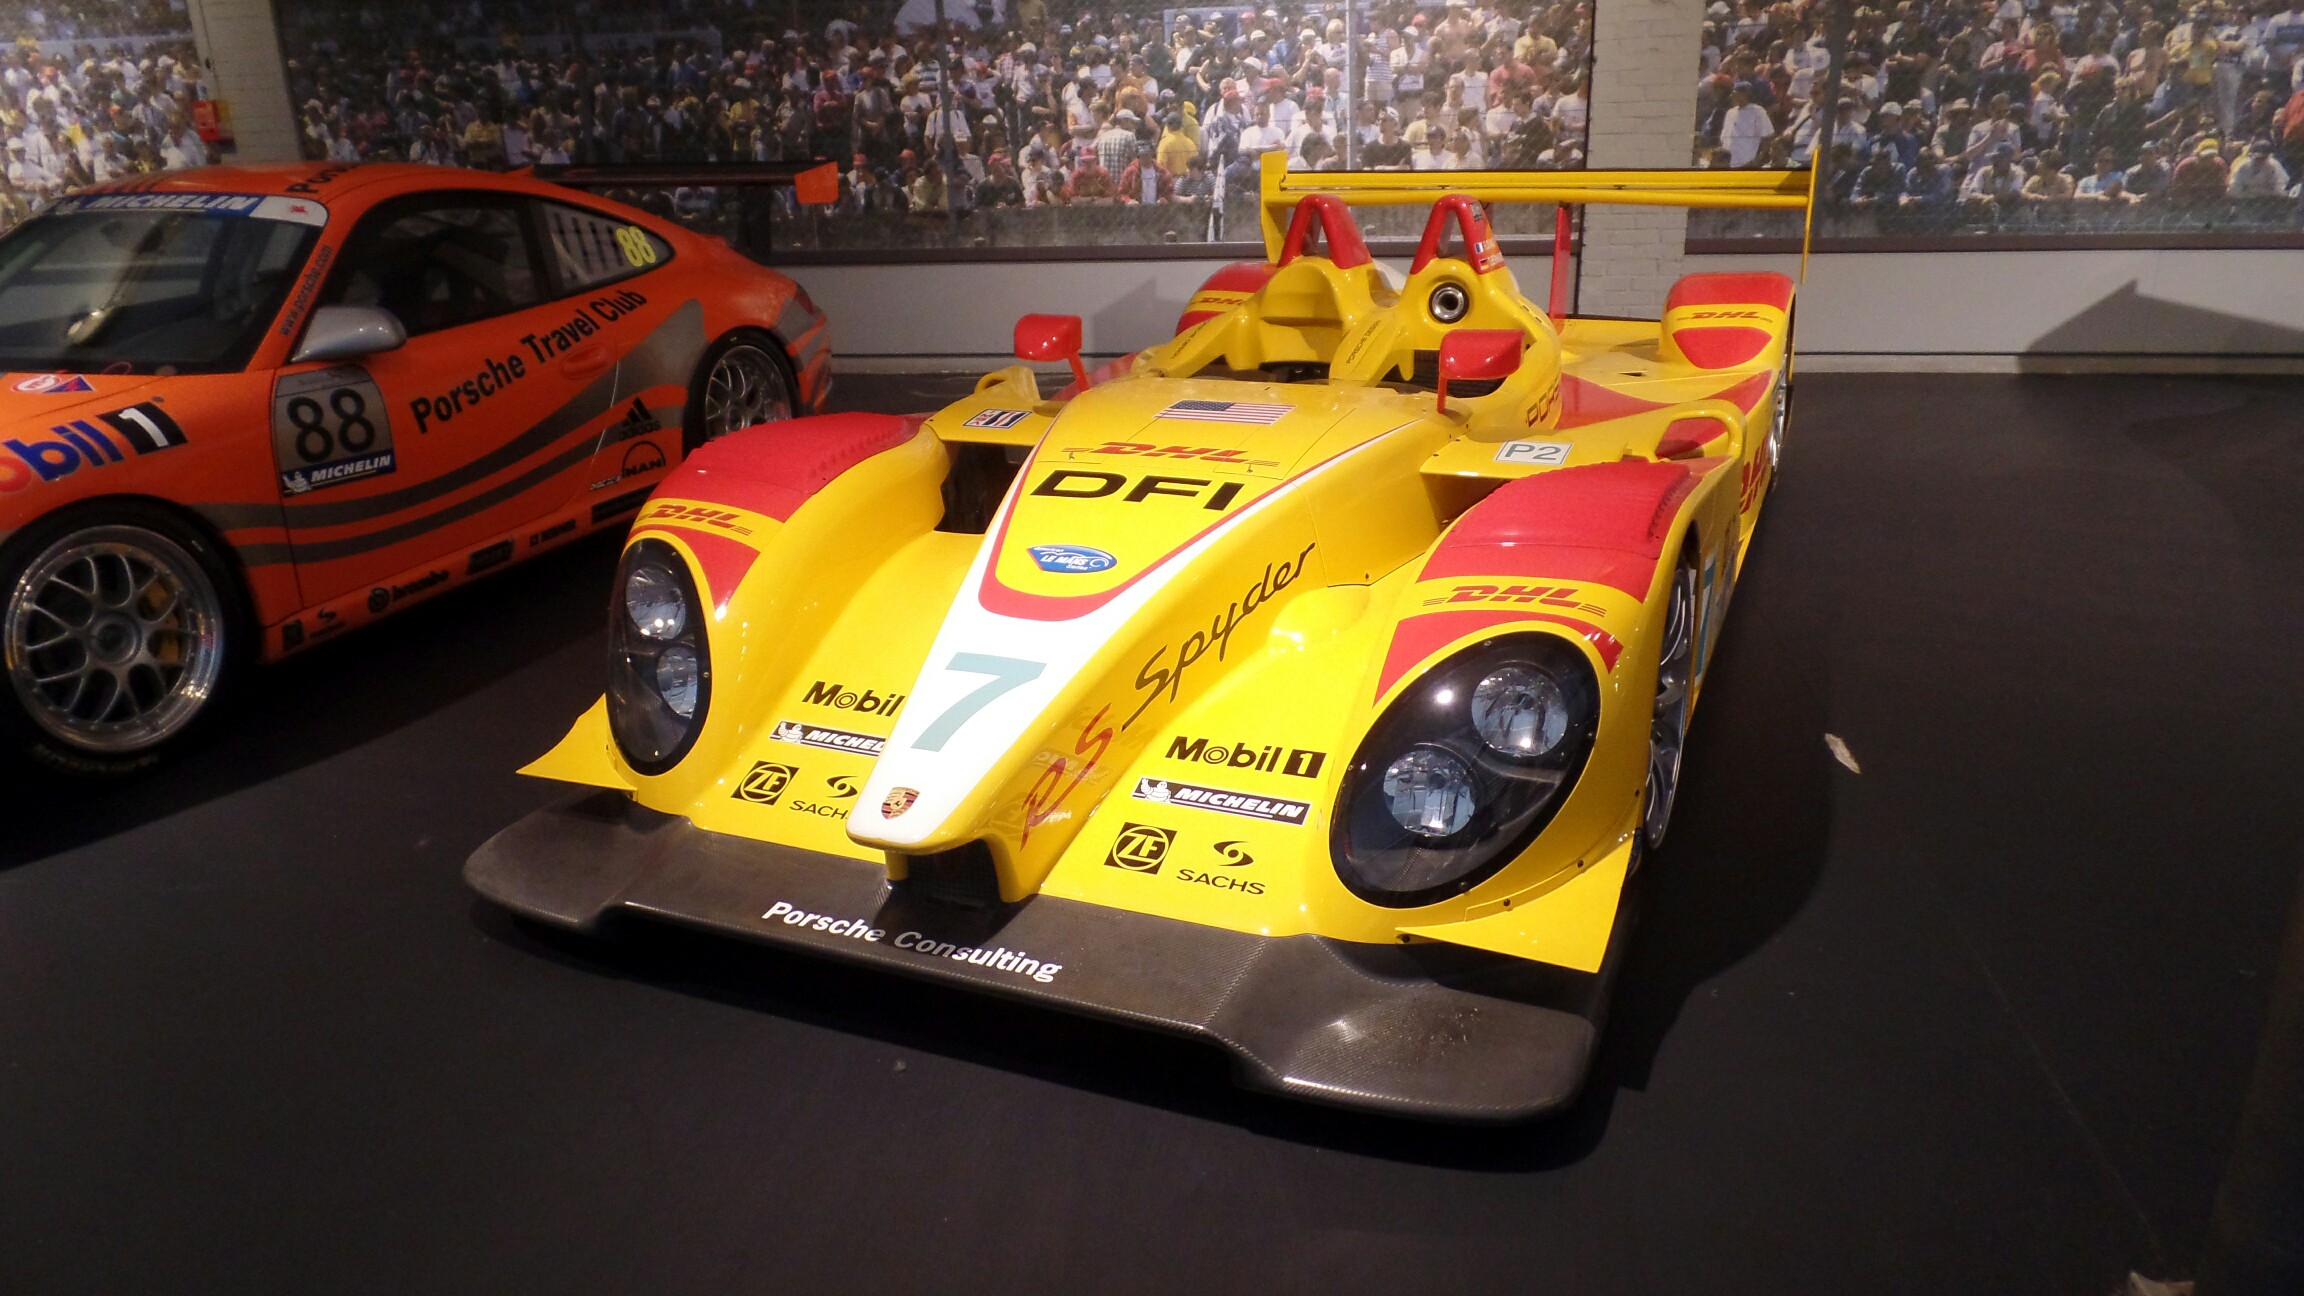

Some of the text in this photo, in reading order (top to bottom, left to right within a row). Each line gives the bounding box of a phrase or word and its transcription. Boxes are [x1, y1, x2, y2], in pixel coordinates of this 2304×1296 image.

[615, 225, 657, 267] 88
[1691, 311, 1760, 319] DHL
[409, 289, 648, 434] Porsche Travel Club
[286, 387, 375, 462] 88
[1090, 441, 1253, 464] DHL
[1504, 443, 1562, 461] P2
[311, 455, 391, 482] MICHELIN
[1029, 469, 1246, 512] DFI
[648, 504, 741, 529] DHL
[1040, 554, 1089, 566] LE MANS
[1446, 584, 1581, 609] DHL
[801, 680, 906, 717] Mobil
[910, 651, 1047, 753] 7
[1020, 542, 1316, 852] RS Spyder
[804, 730, 887, 752] MICHEL
[1165, 735, 1284, 773] Mobil
[744, 769, 787, 796] ZF
[788, 800, 850, 820] SACH
[1172, 787, 1305, 819] MICHELIN
[1116, 832, 1166, 863] ZF
[1176, 868, 1267, 896] SACHS
[762, 900, 1063, 983] Porsche Consulting
